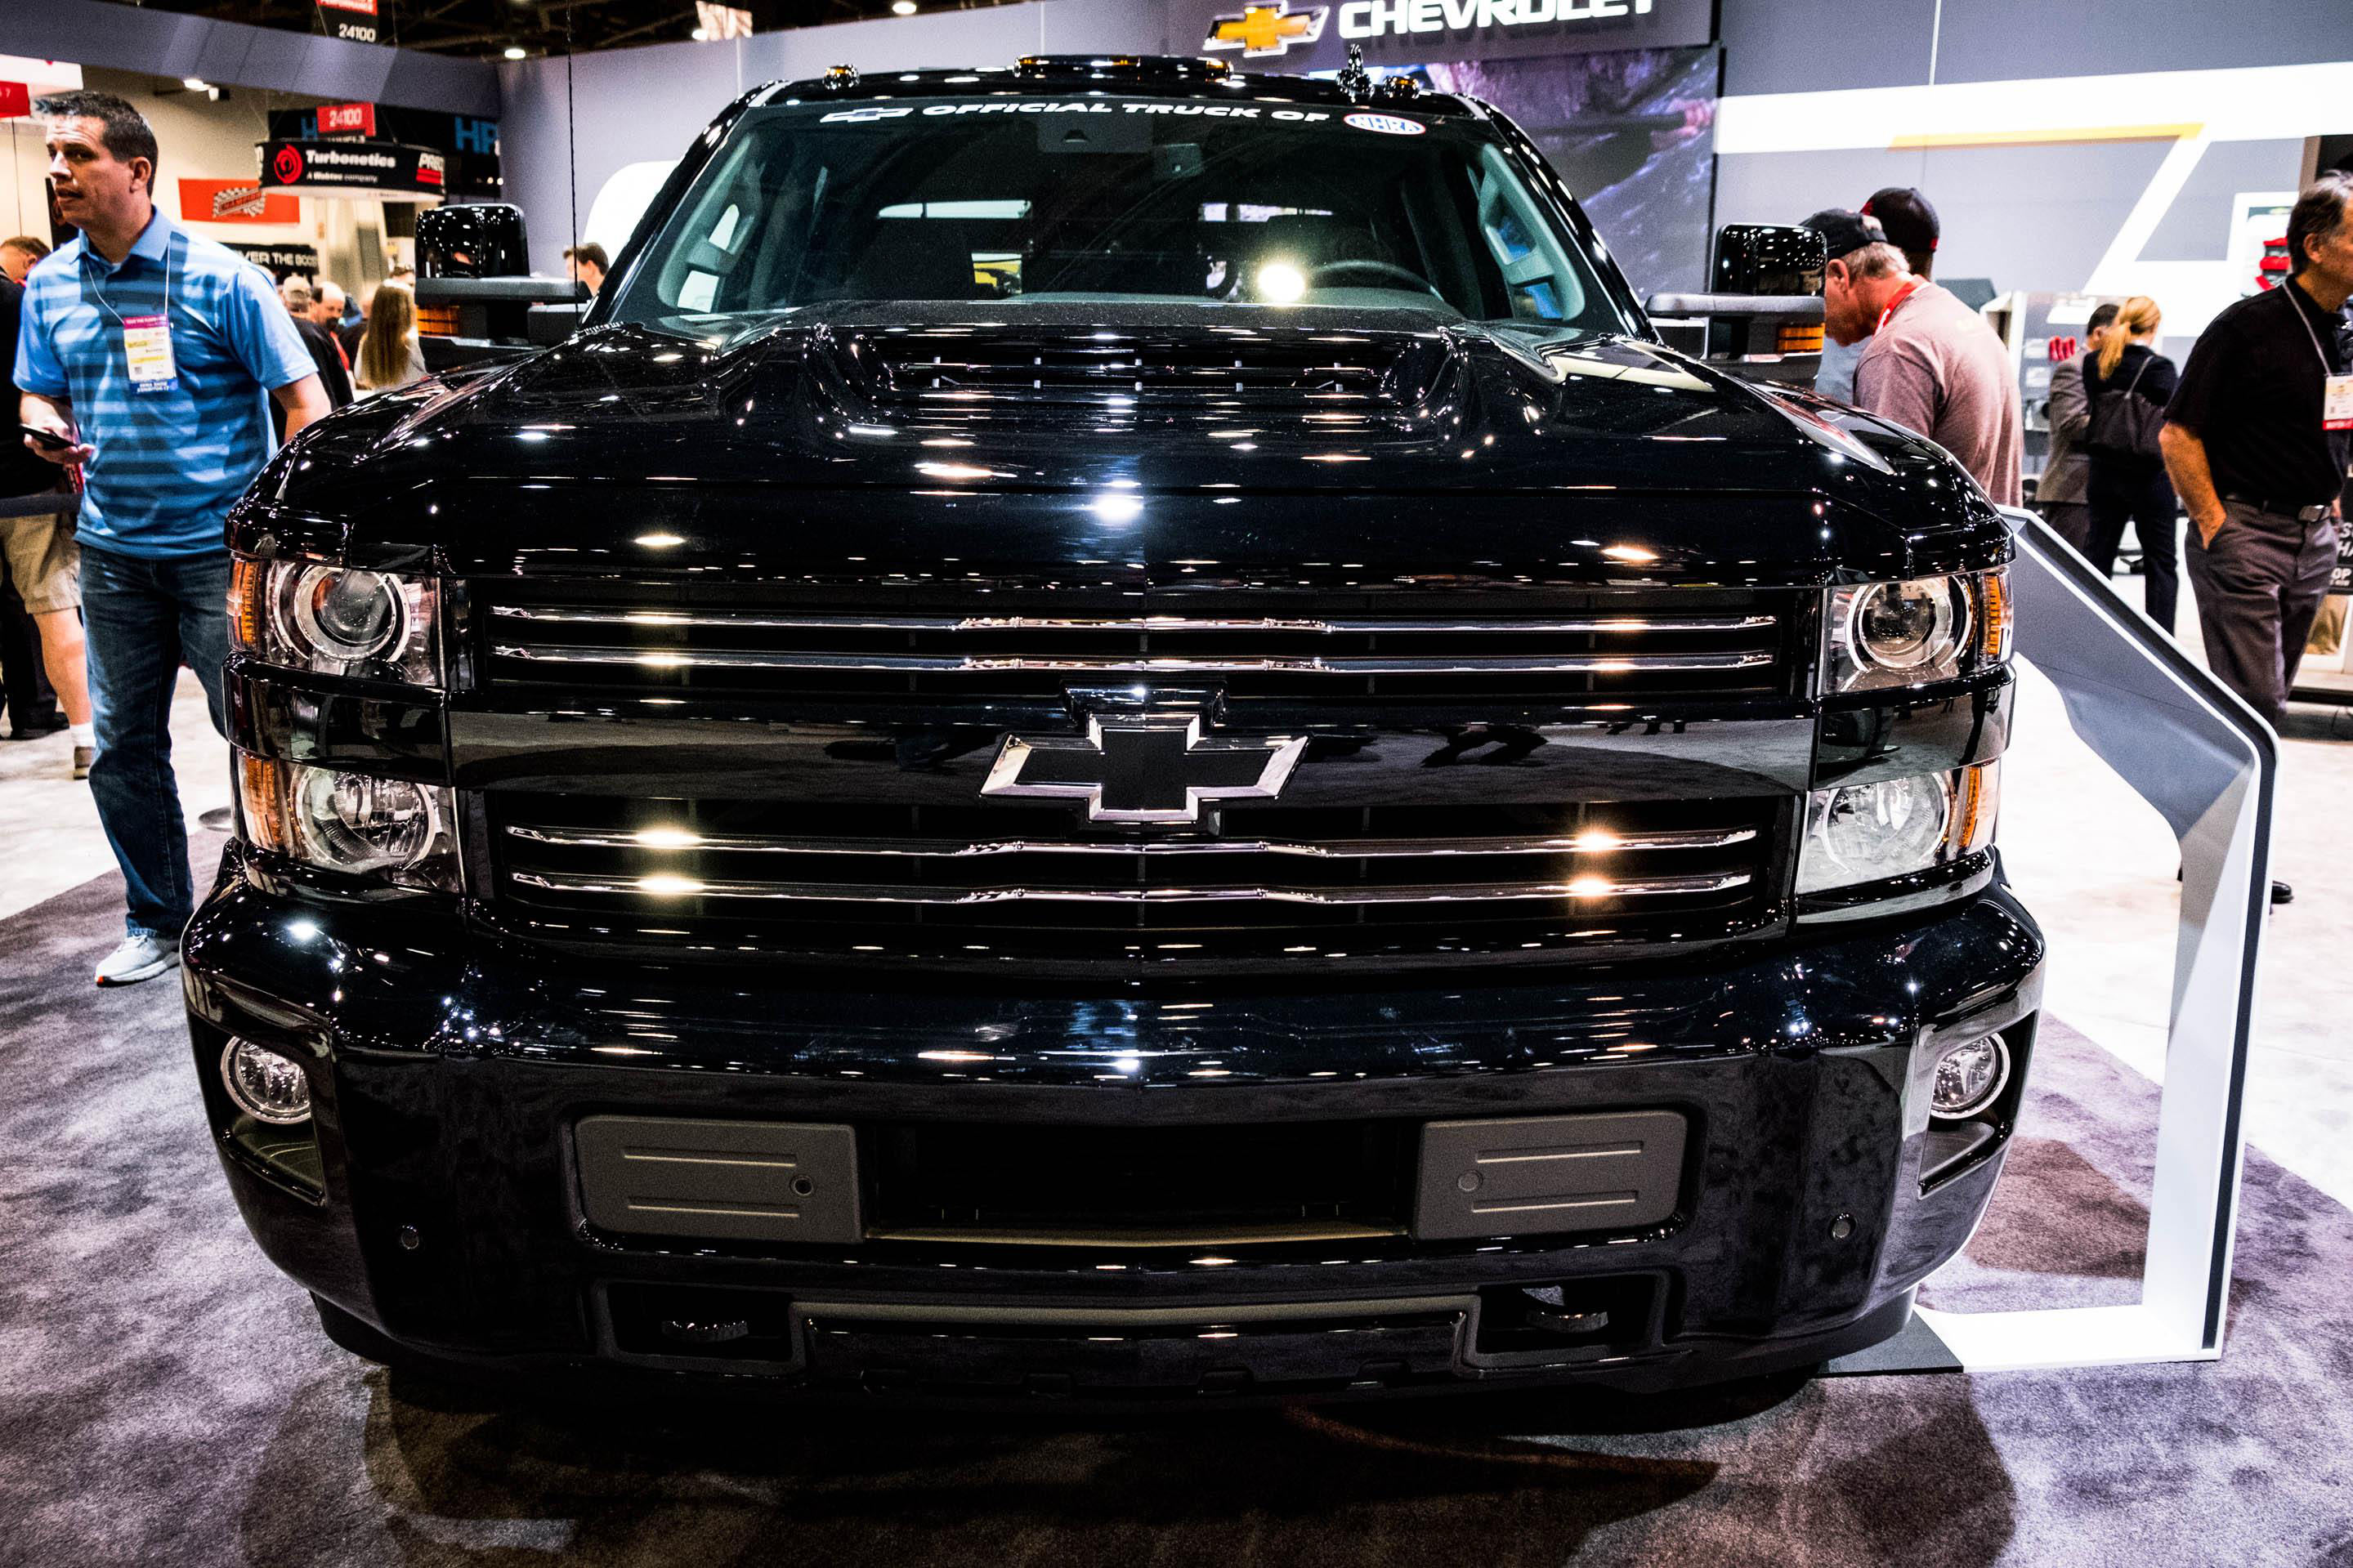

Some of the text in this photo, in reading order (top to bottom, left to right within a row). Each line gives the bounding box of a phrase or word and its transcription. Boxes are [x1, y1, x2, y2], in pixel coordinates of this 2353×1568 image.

[338, 23, 376, 42] 24100
[329, 108, 362, 127] 24100
[922, 103, 1421, 135] OFFICIAL TRUCK OF NHRA
[306, 150, 396, 168] Turbonetics
[271, 252, 293, 266] THE
